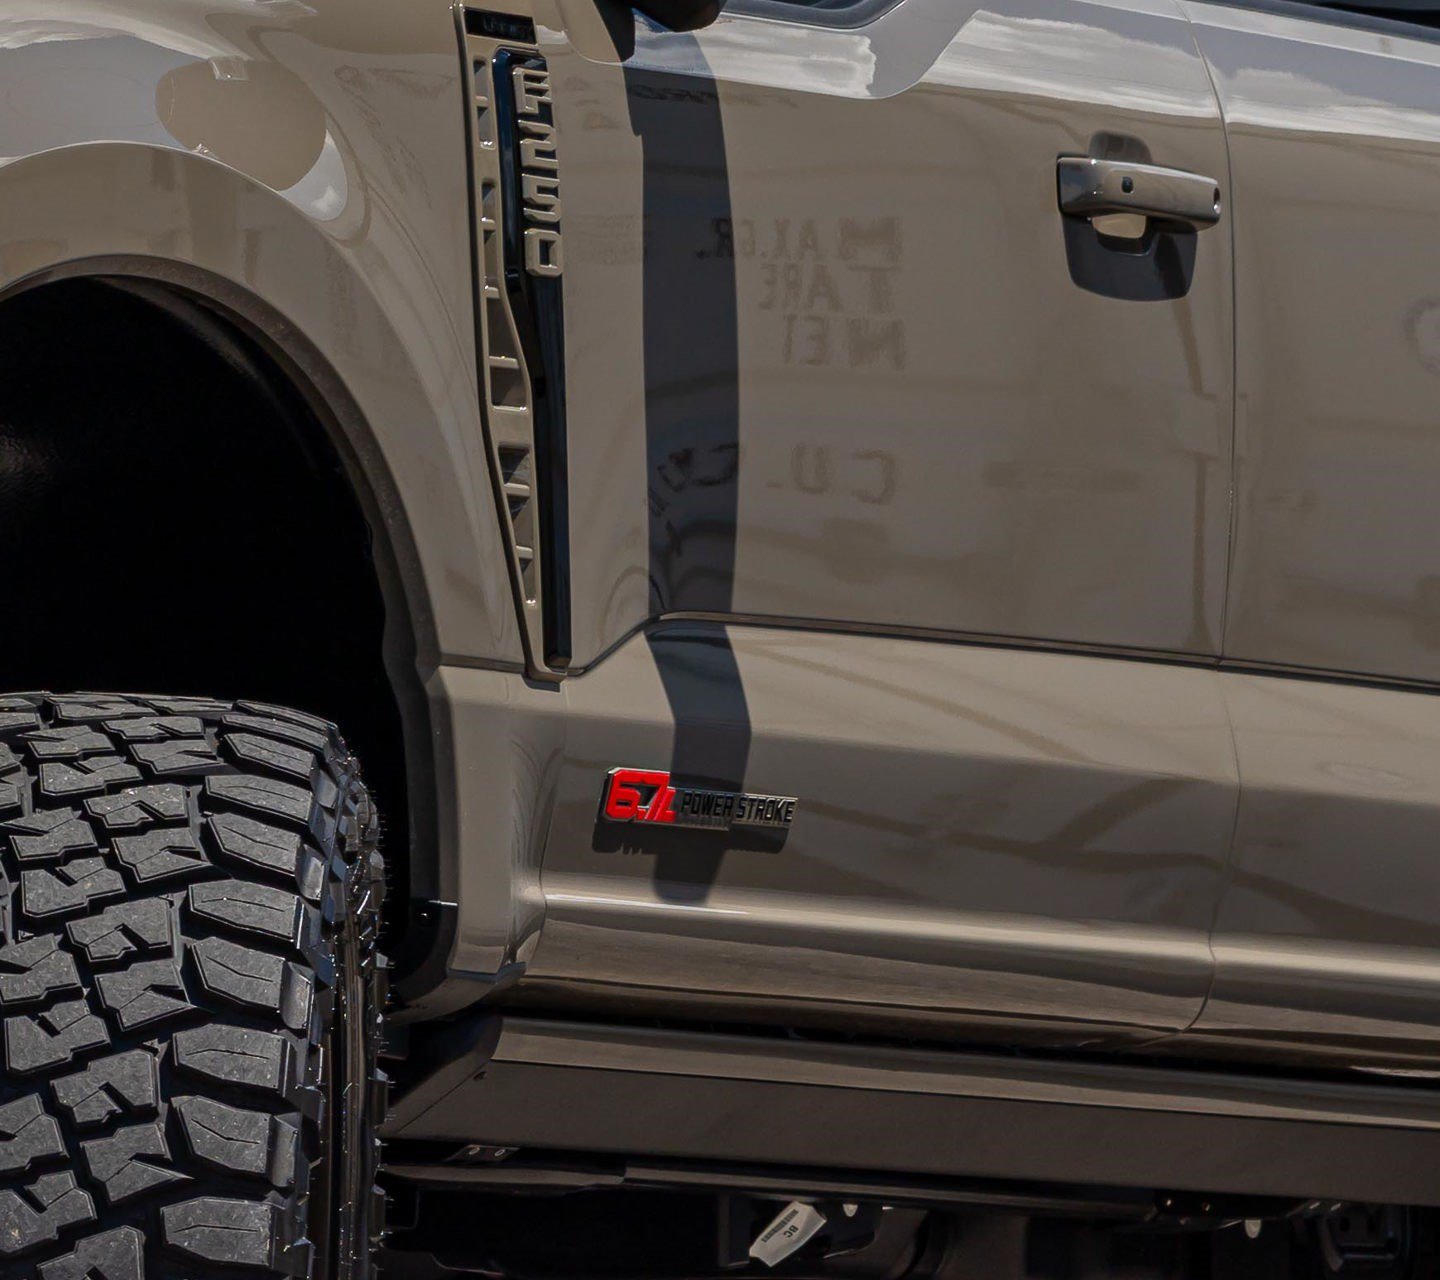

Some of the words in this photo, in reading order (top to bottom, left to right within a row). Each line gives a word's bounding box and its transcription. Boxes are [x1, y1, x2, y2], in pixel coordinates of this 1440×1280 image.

[512, 67, 564, 278] F250
[680, 790, 733, 817] POWER
[735, 796, 796, 822] STROKE
